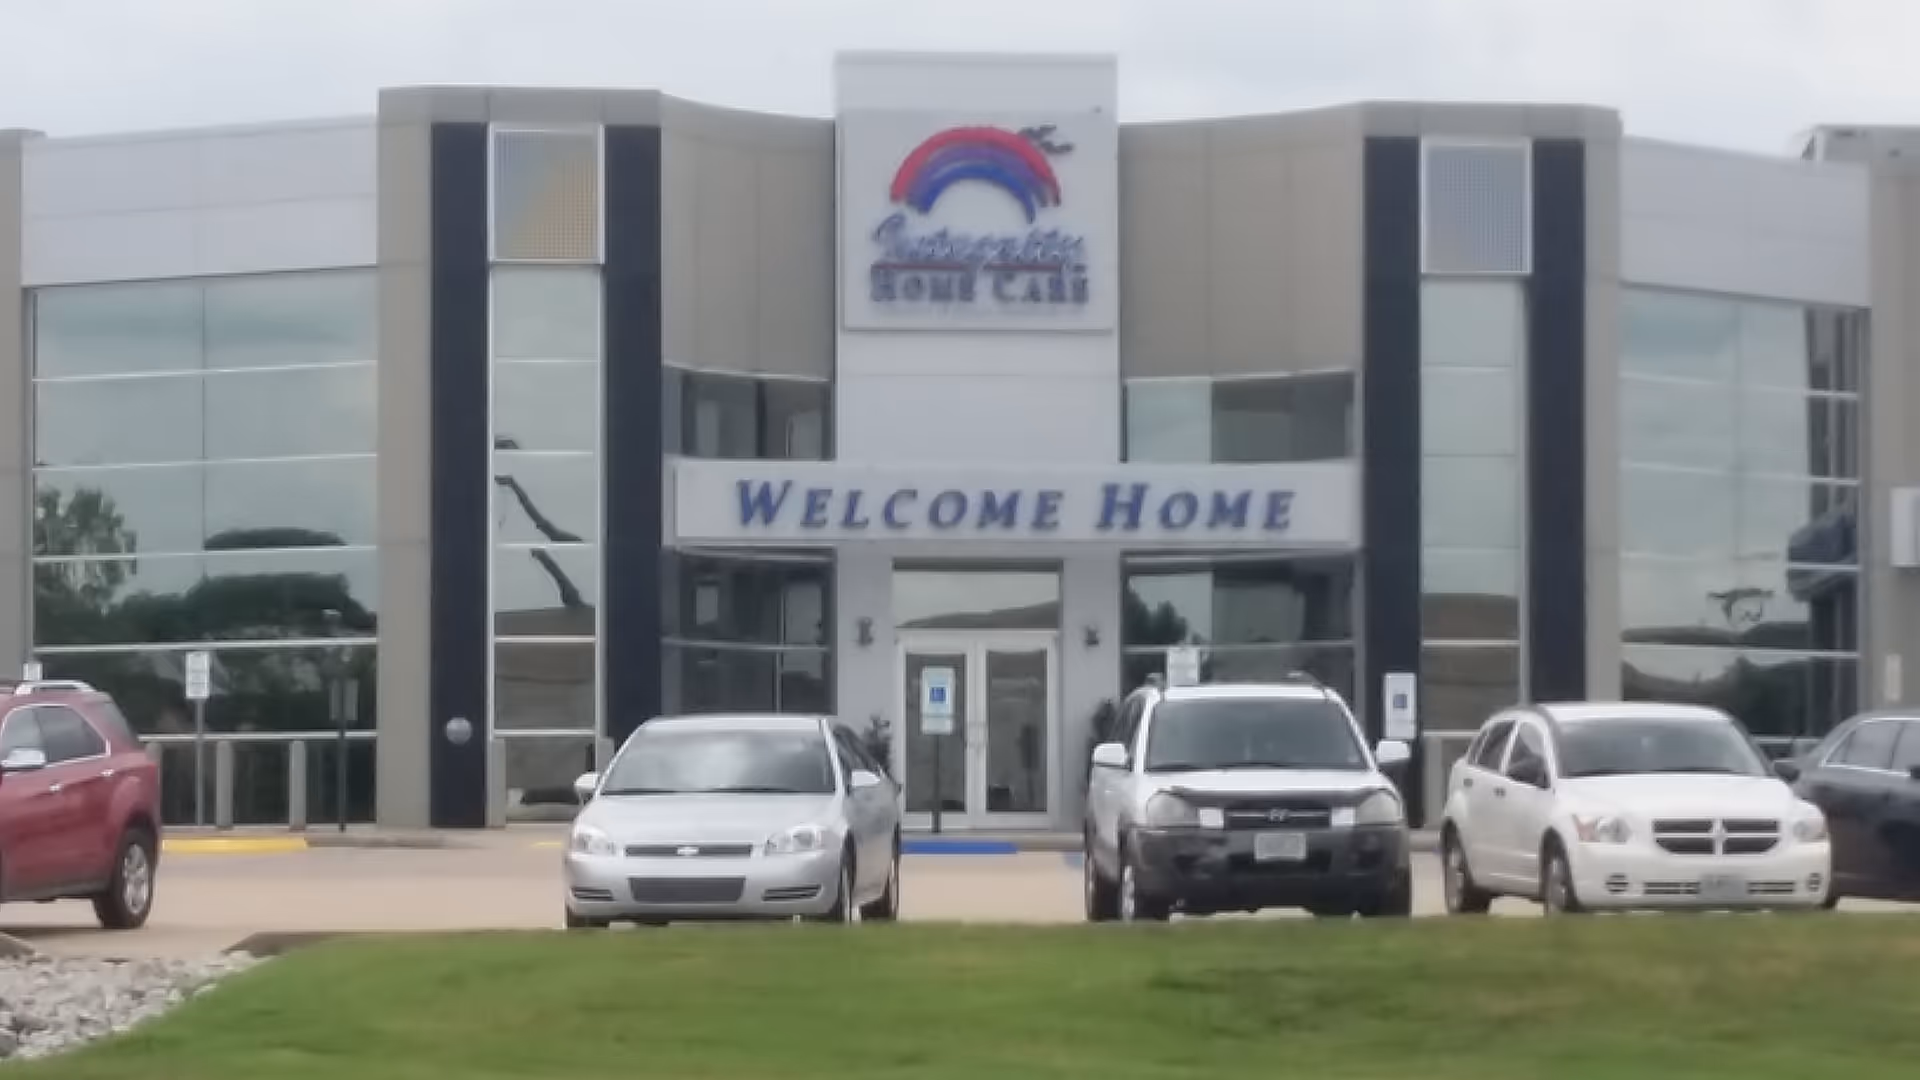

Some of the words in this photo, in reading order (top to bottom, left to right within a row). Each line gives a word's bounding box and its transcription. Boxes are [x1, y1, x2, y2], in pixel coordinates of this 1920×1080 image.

[870, 266, 977, 302] HOME
[992, 269, 1089, 304] CARE
[735, 478, 1065, 530] WELCOME
[1095, 482, 1297, 531] HOME
